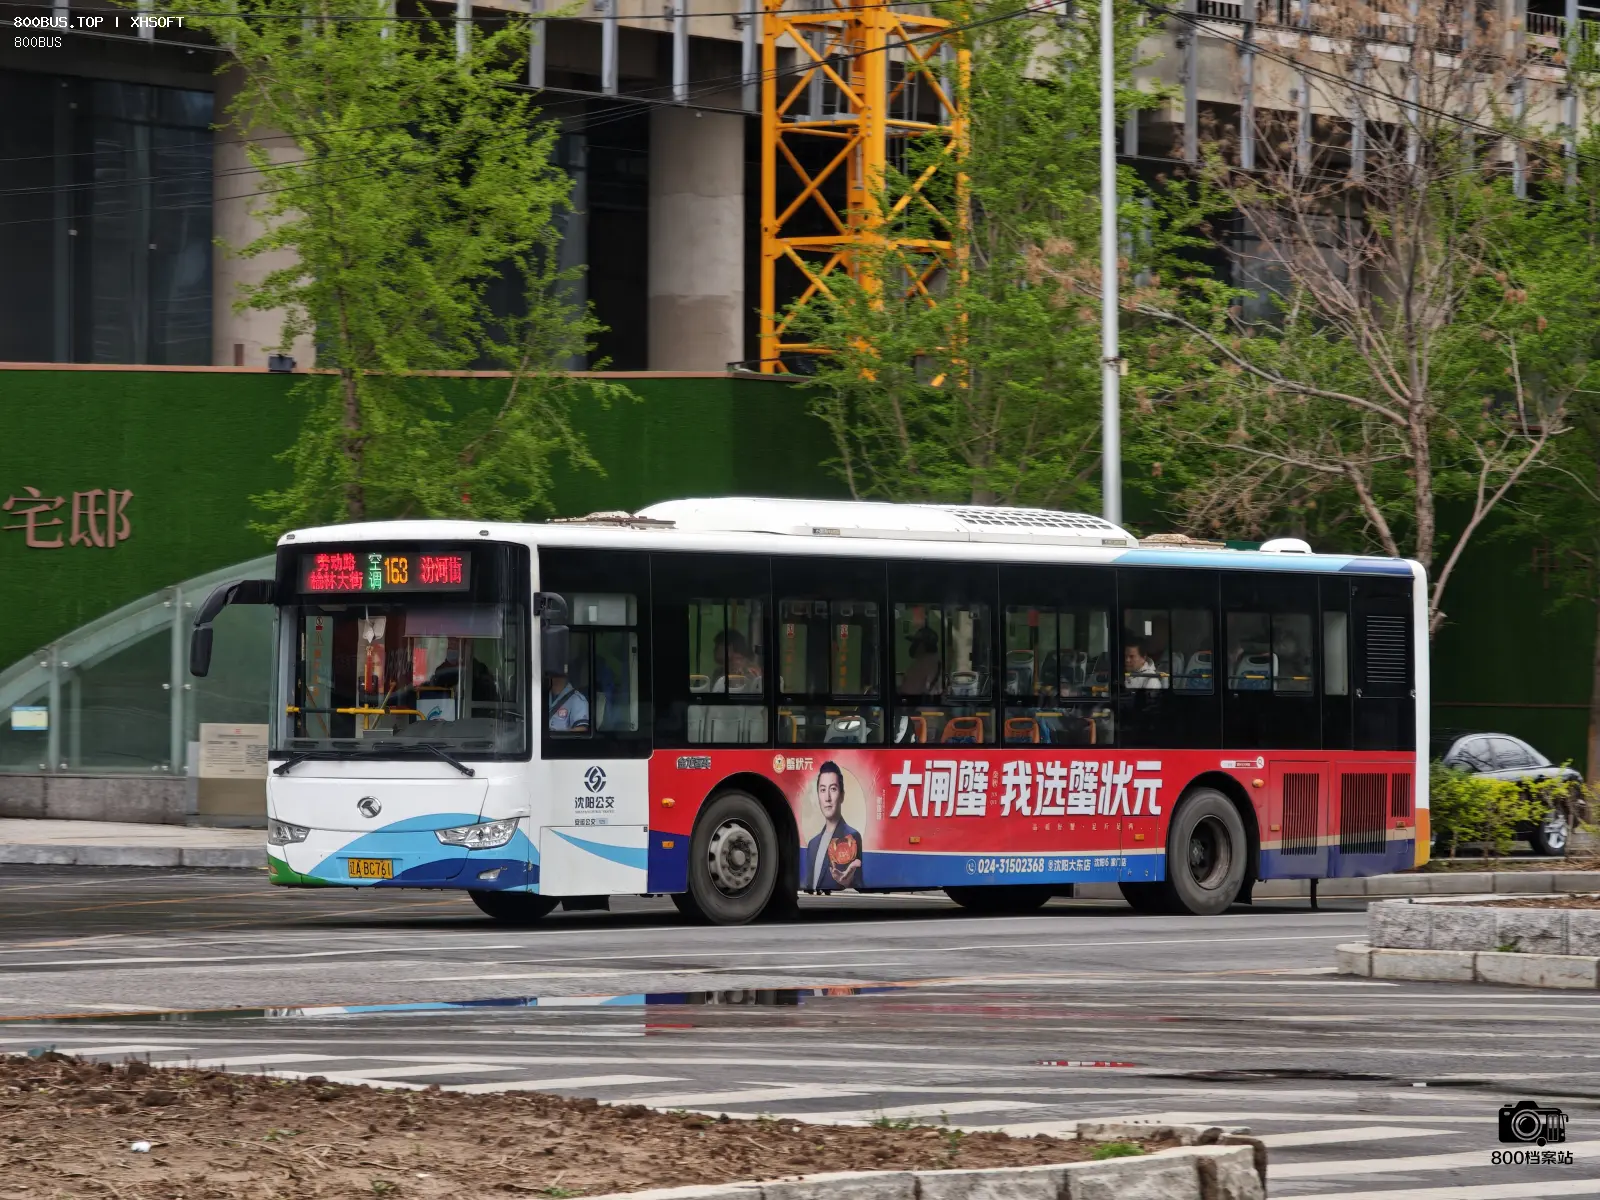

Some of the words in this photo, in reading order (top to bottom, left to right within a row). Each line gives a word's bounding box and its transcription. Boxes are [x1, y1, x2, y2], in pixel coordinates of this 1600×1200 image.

[2, 486, 134, 548] 宅邸
[315, 553, 356, 571] 劳动路
[368, 553, 382, 590] 空调
[384, 557, 409, 584] 163
[420, 556, 463, 584] 汾河街
[889, 759, 990, 818] 大闸蟹
[1000, 759, 1163, 817] 我选蟹状元
[574, 796, 615, 809] 沈阳公交
[977, 857, 1045, 874] 024-31502368
[1053, 859, 1091, 872] 沈阳大东店
